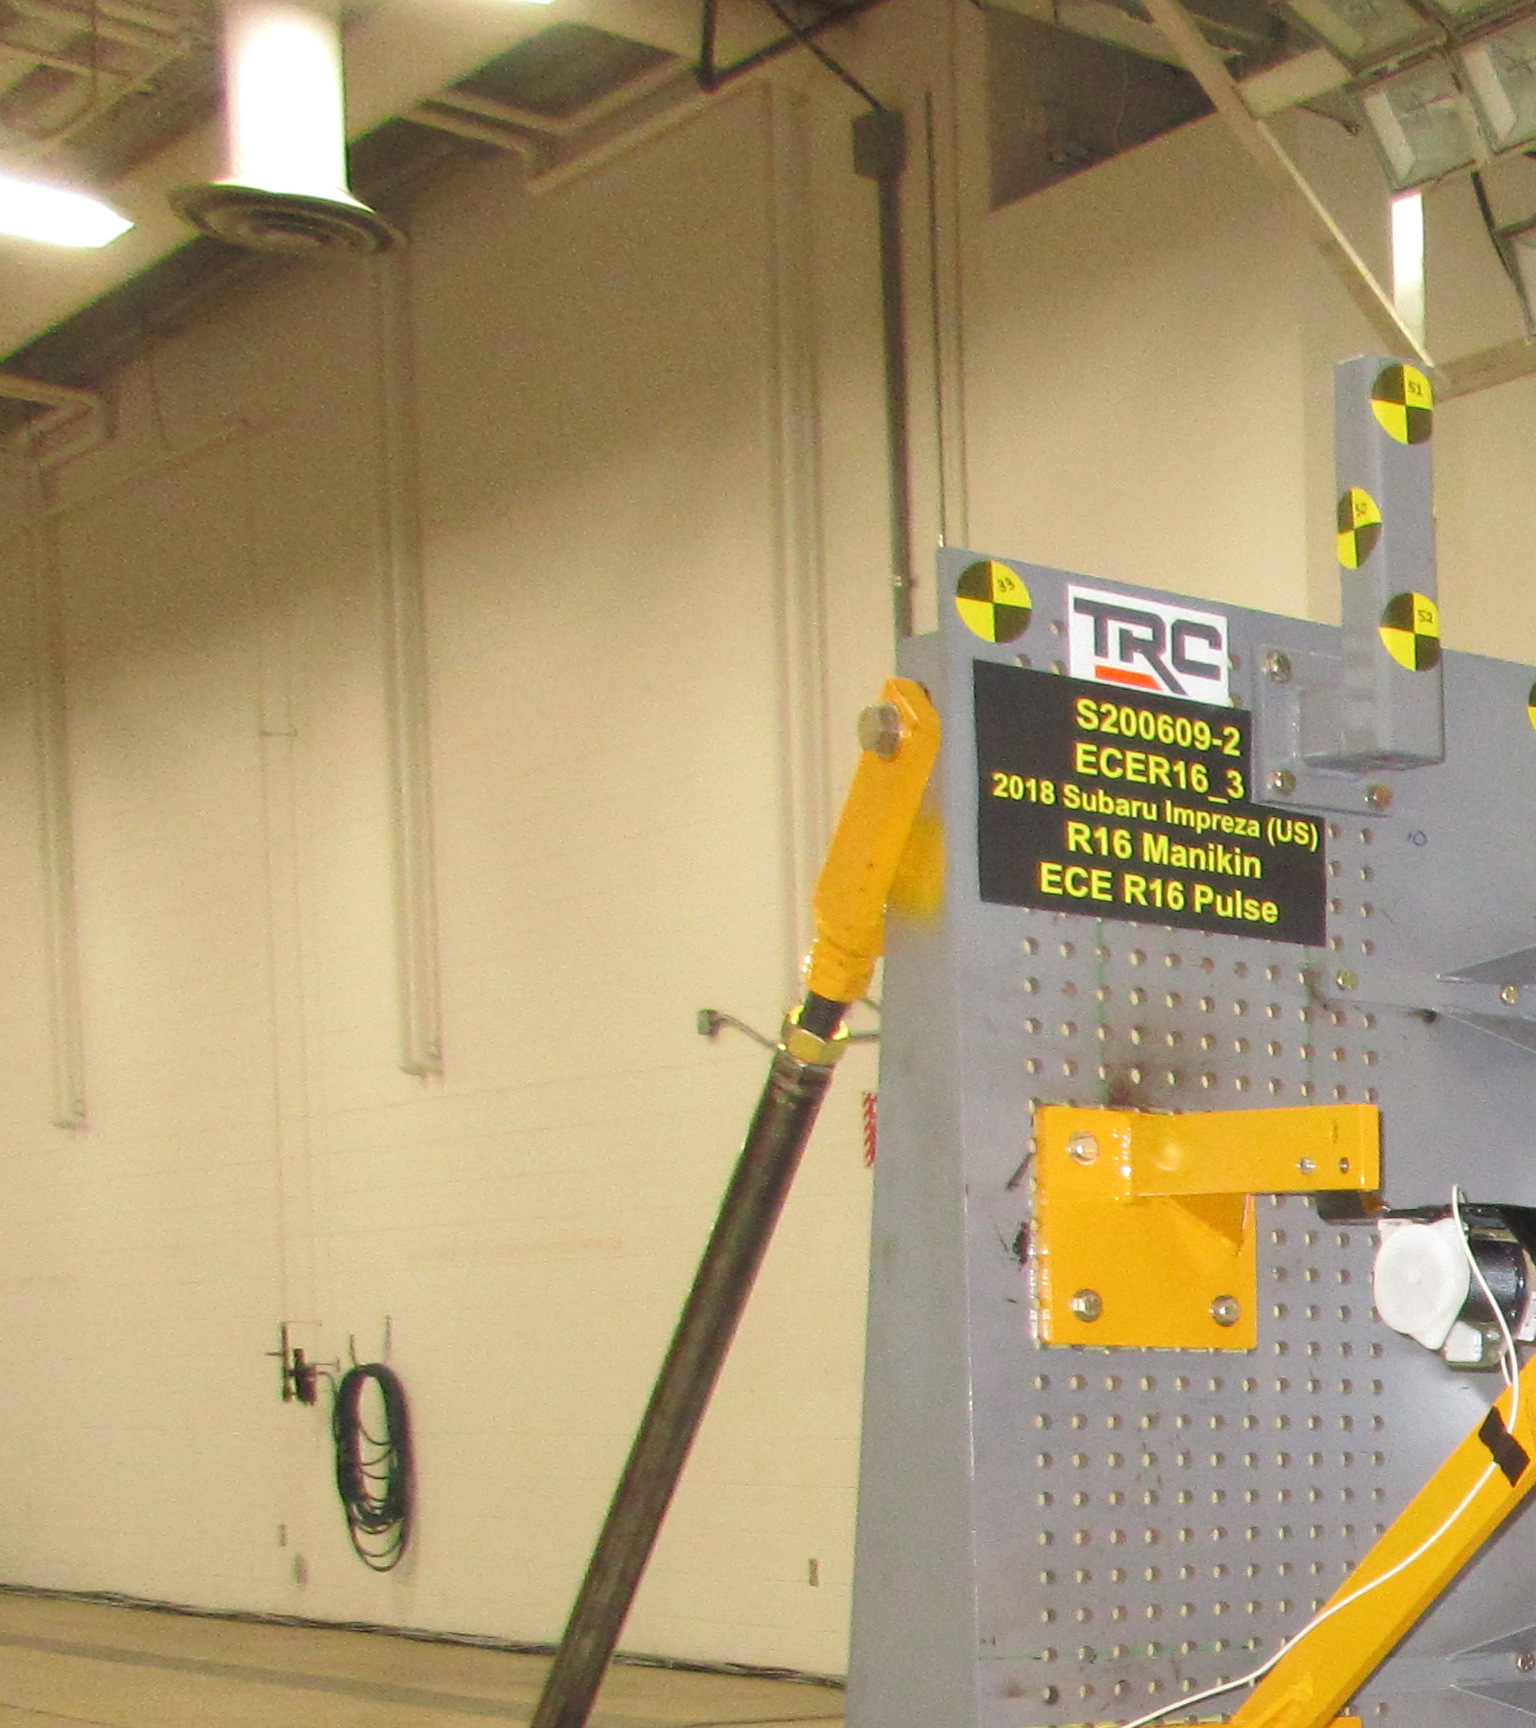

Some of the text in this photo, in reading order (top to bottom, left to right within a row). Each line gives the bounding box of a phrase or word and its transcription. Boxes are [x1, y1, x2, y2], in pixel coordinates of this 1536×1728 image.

[1407, 381, 1423, 396] 51
[997, 577, 1015, 592] 33
[1418, 609, 1433, 623] 52
[1073, 597, 1223, 696] TRC
[1075, 698, 1241, 757] S200609-2
[1075, 742, 1245, 804] ECER16_3
[992, 772, 1319, 851] 2018 Subaru Impreza (US)
[1067, 821, 1263, 879] R16 Manikin
[1039, 861, 1279, 924] ECE R16 Pulse
